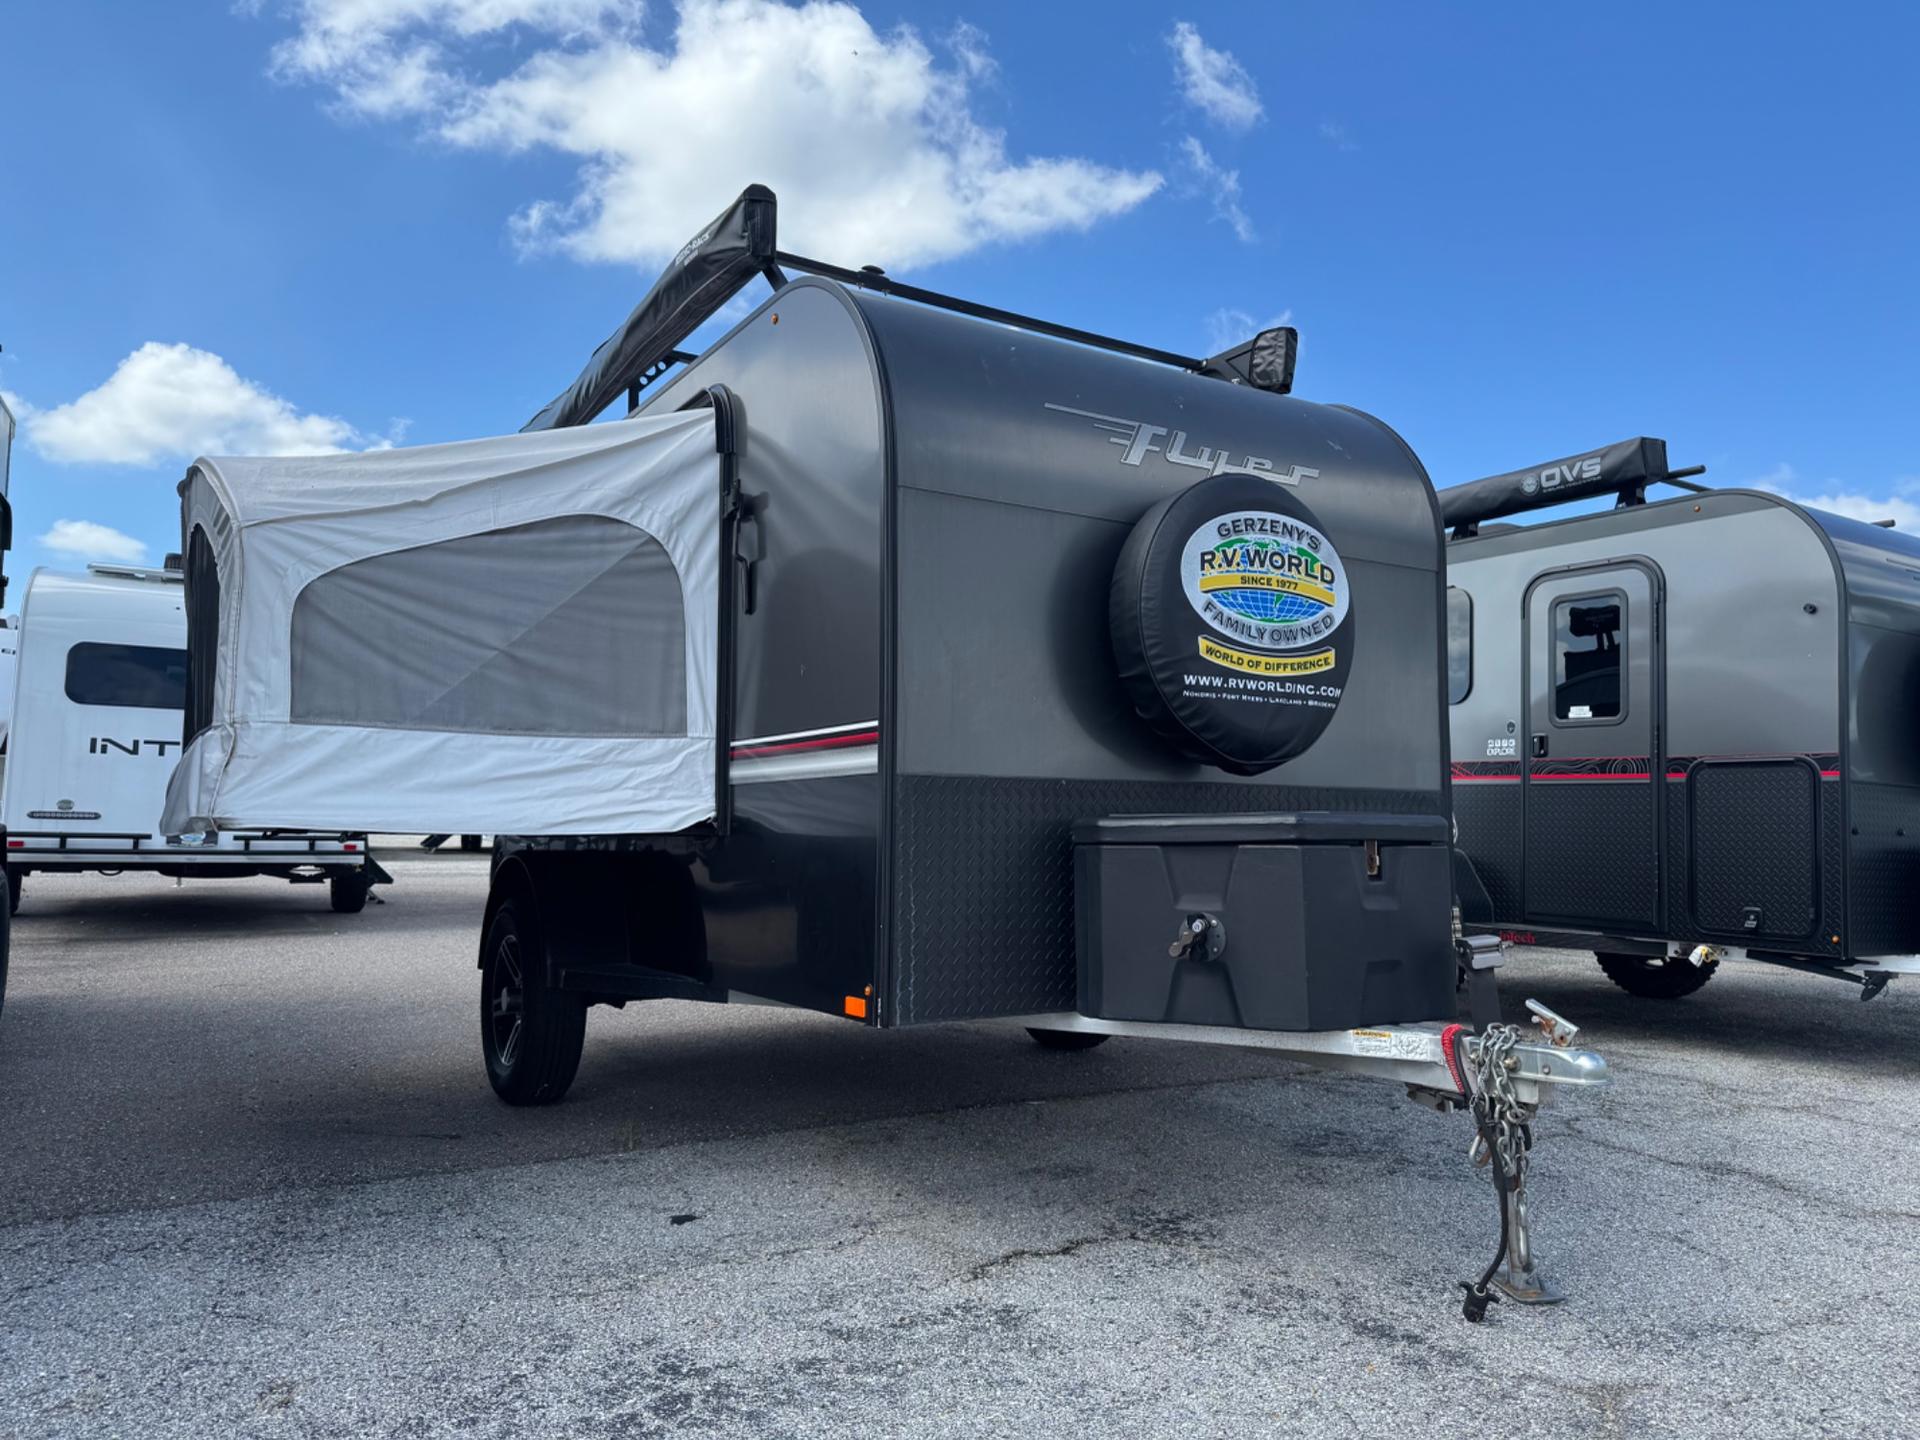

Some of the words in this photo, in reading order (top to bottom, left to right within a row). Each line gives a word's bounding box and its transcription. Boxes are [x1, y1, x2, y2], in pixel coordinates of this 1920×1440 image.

[1045, 402, 1321, 487] Flyer
[1540, 456, 1601, 489] OVS
[1217, 517, 1321, 552] GERZENY'S
[1200, 548, 1241, 572] R.V.
[1246, 548, 1335, 585] WORLD
[1240, 575, 1273, 587] SINCE
[1276, 579, 1299, 591] 1977
[1203, 601, 1268, 641] FAMILY
[1271, 613, 1334, 642] OWNED
[1205, 644, 1245, 667] WORLD
[1247, 658, 1262, 670] OF
[1264, 656, 1331, 672] DIFFERENCE
